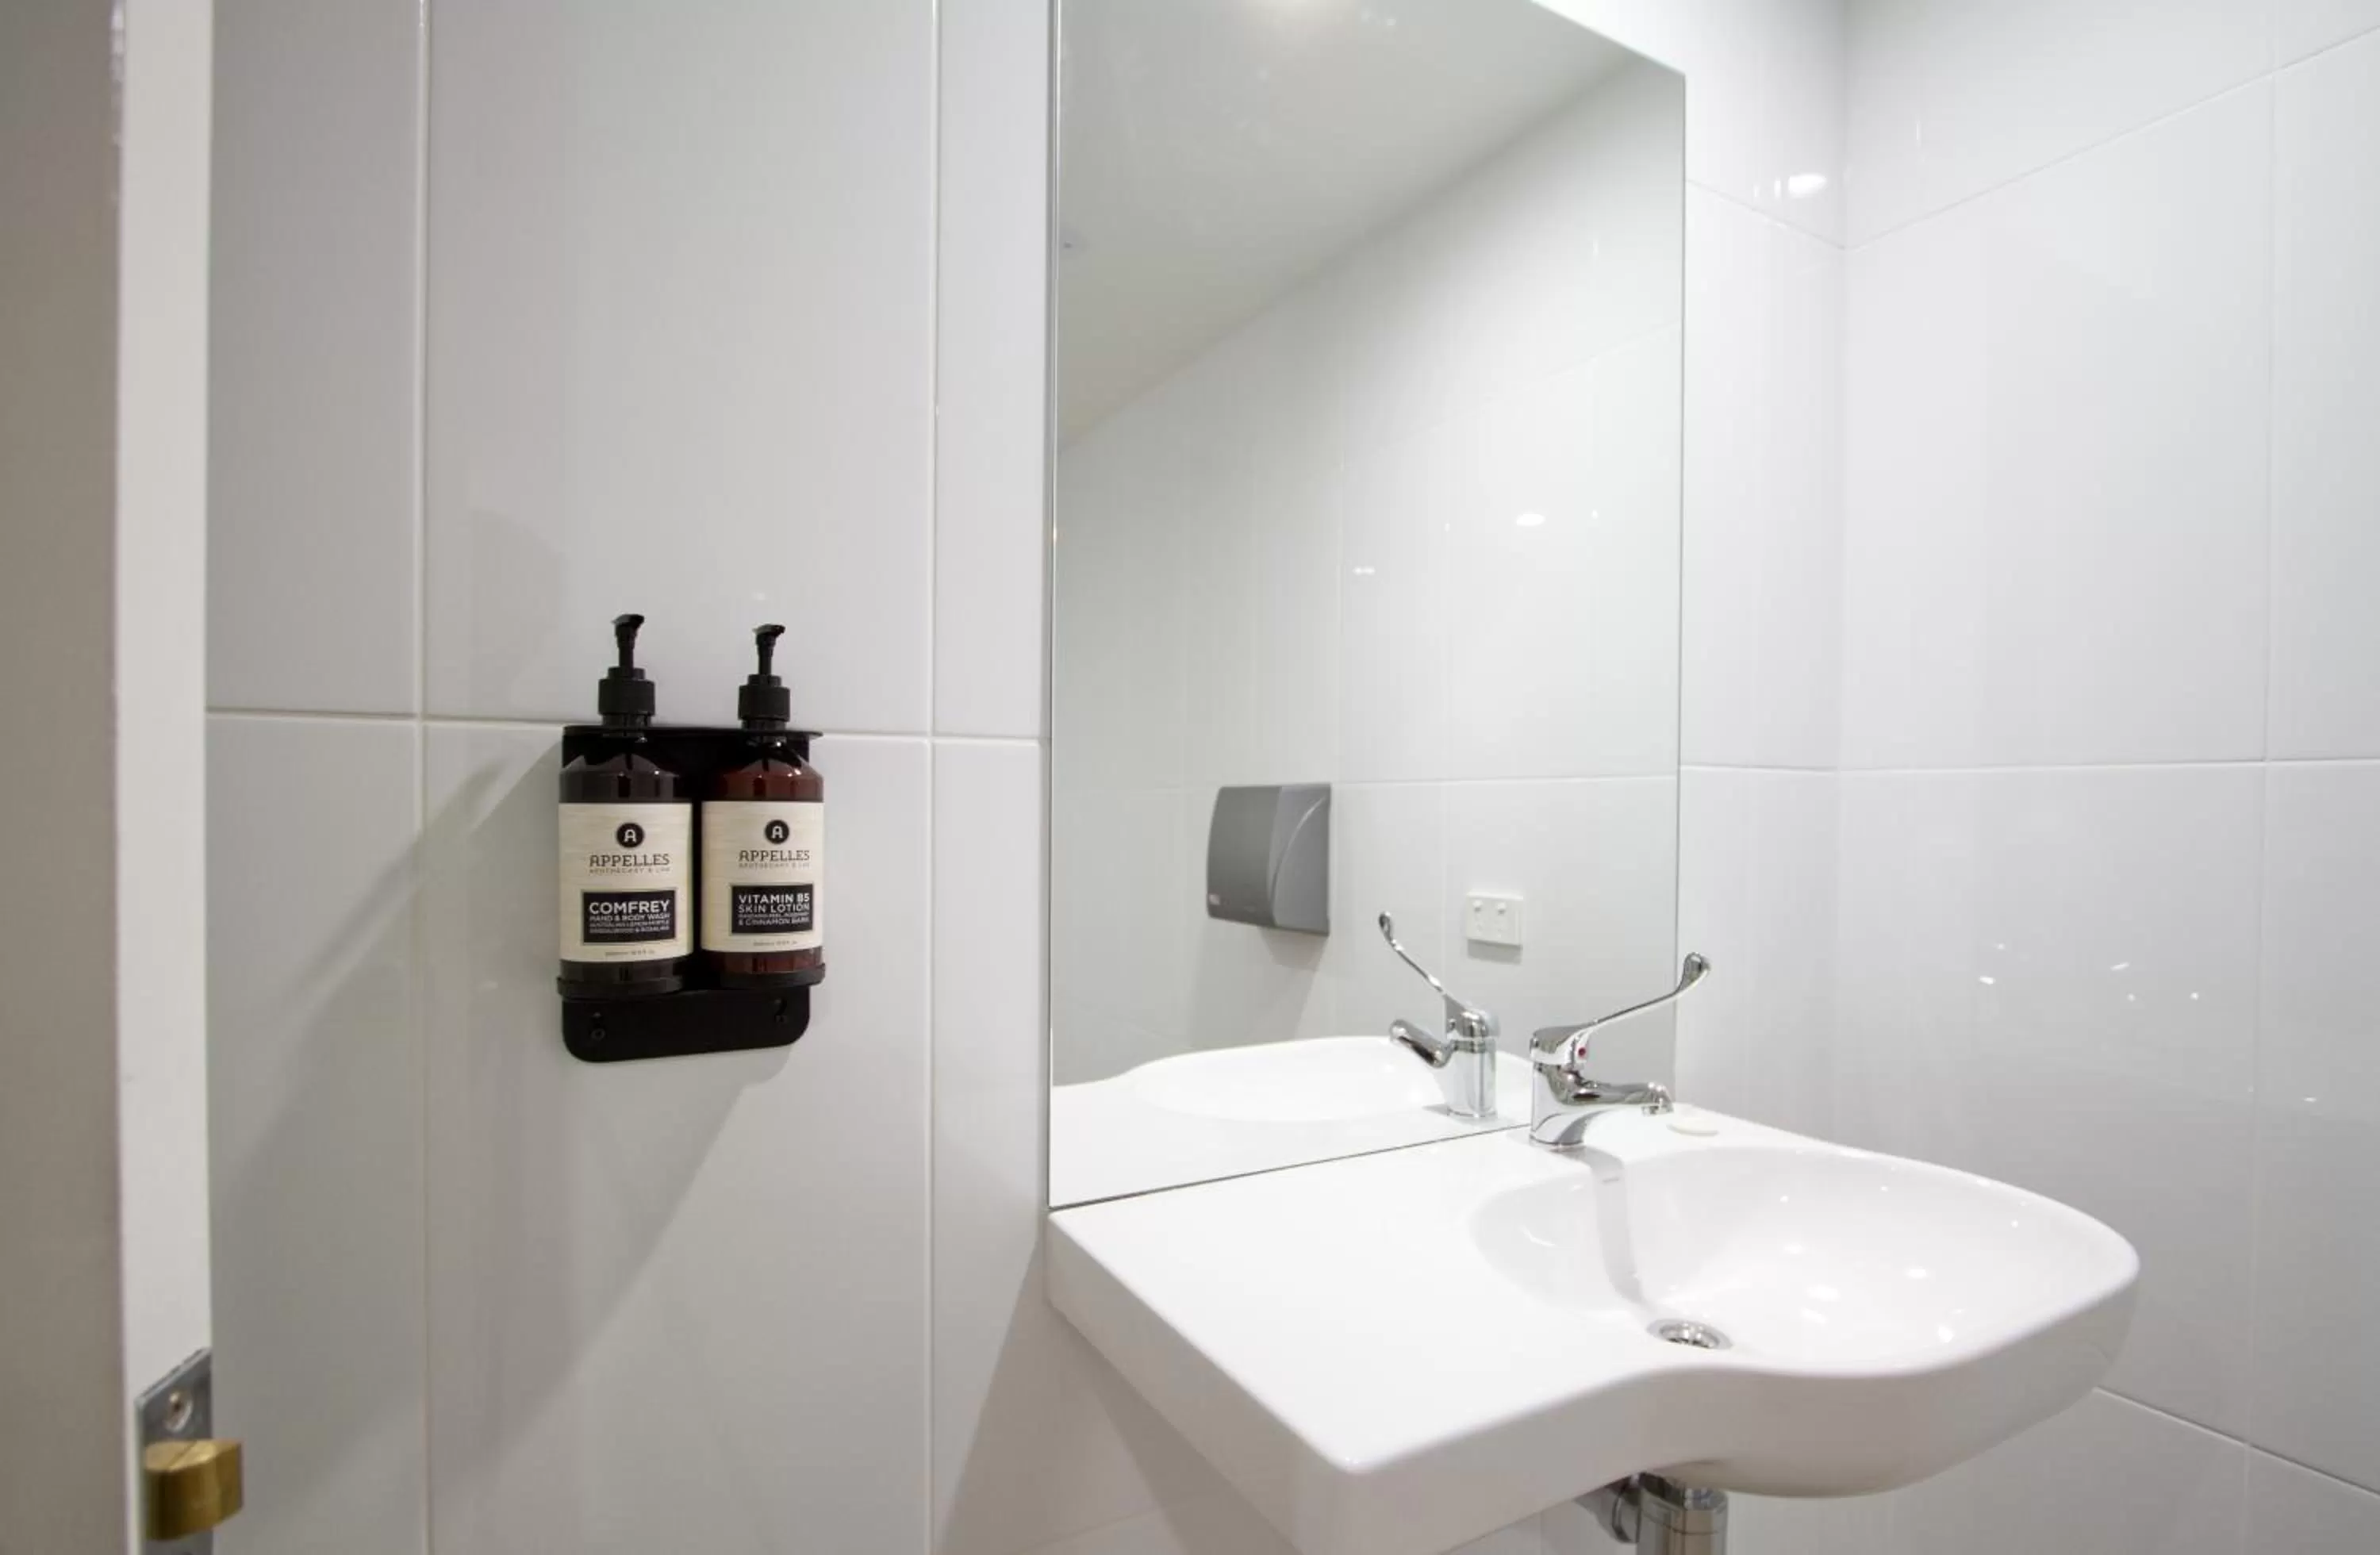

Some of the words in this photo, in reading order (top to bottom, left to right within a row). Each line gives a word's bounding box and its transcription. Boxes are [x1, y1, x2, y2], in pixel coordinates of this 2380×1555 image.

[589, 854, 670, 867] APPELLES
[739, 850, 810, 862] APPELLES
[739, 894, 793, 904] VITAMIN
[797, 893, 810, 902] B5
[589, 900, 670, 914] COMFREY
[739, 904, 766, 913] SKIN
[770, 903, 810, 913] LOTION
